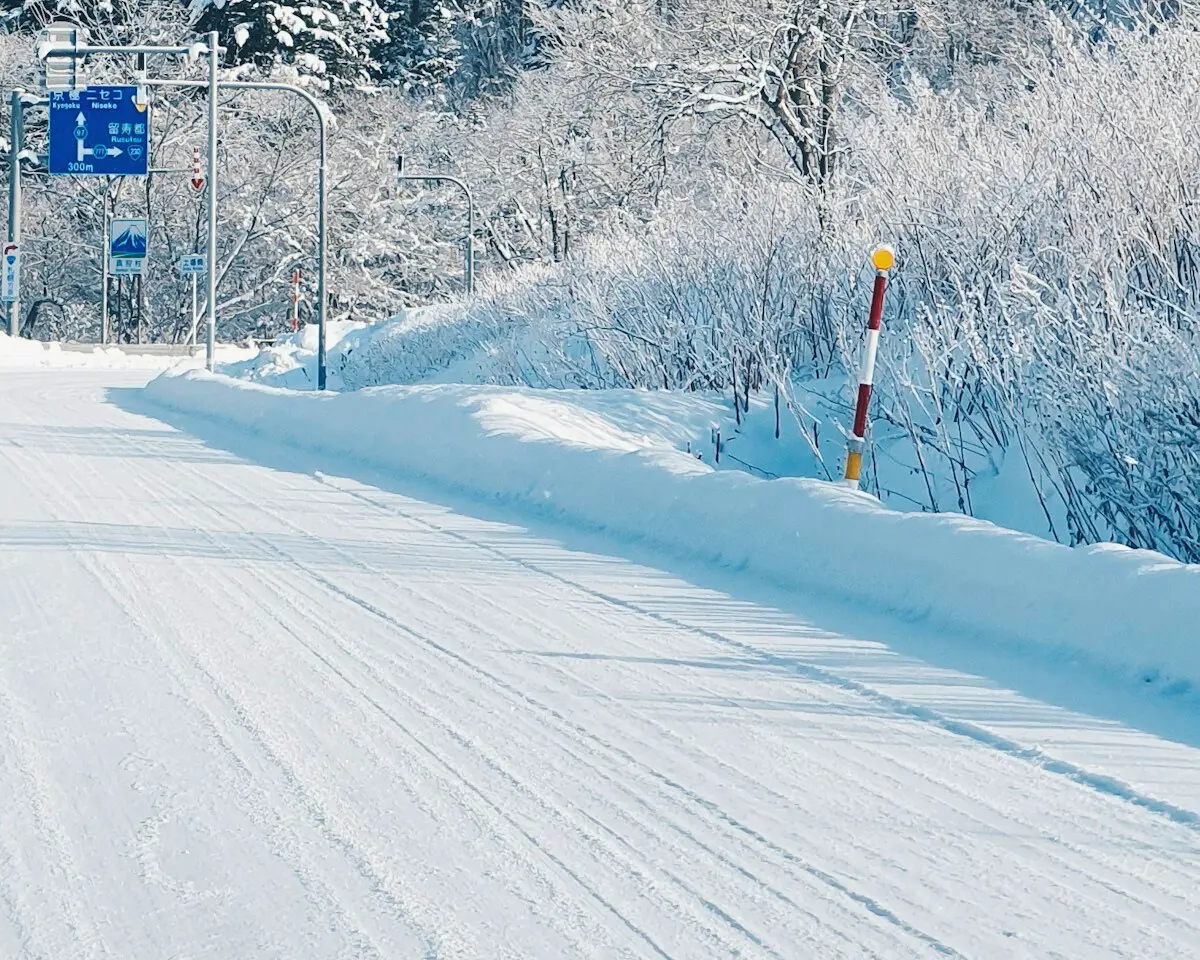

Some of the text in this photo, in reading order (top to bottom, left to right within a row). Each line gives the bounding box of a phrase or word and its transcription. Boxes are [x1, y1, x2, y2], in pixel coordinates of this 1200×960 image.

[86, 89, 123, 101] ニセコ
[108, 122, 145, 135] 留寿都
[67, 162, 94, 172] 300m
